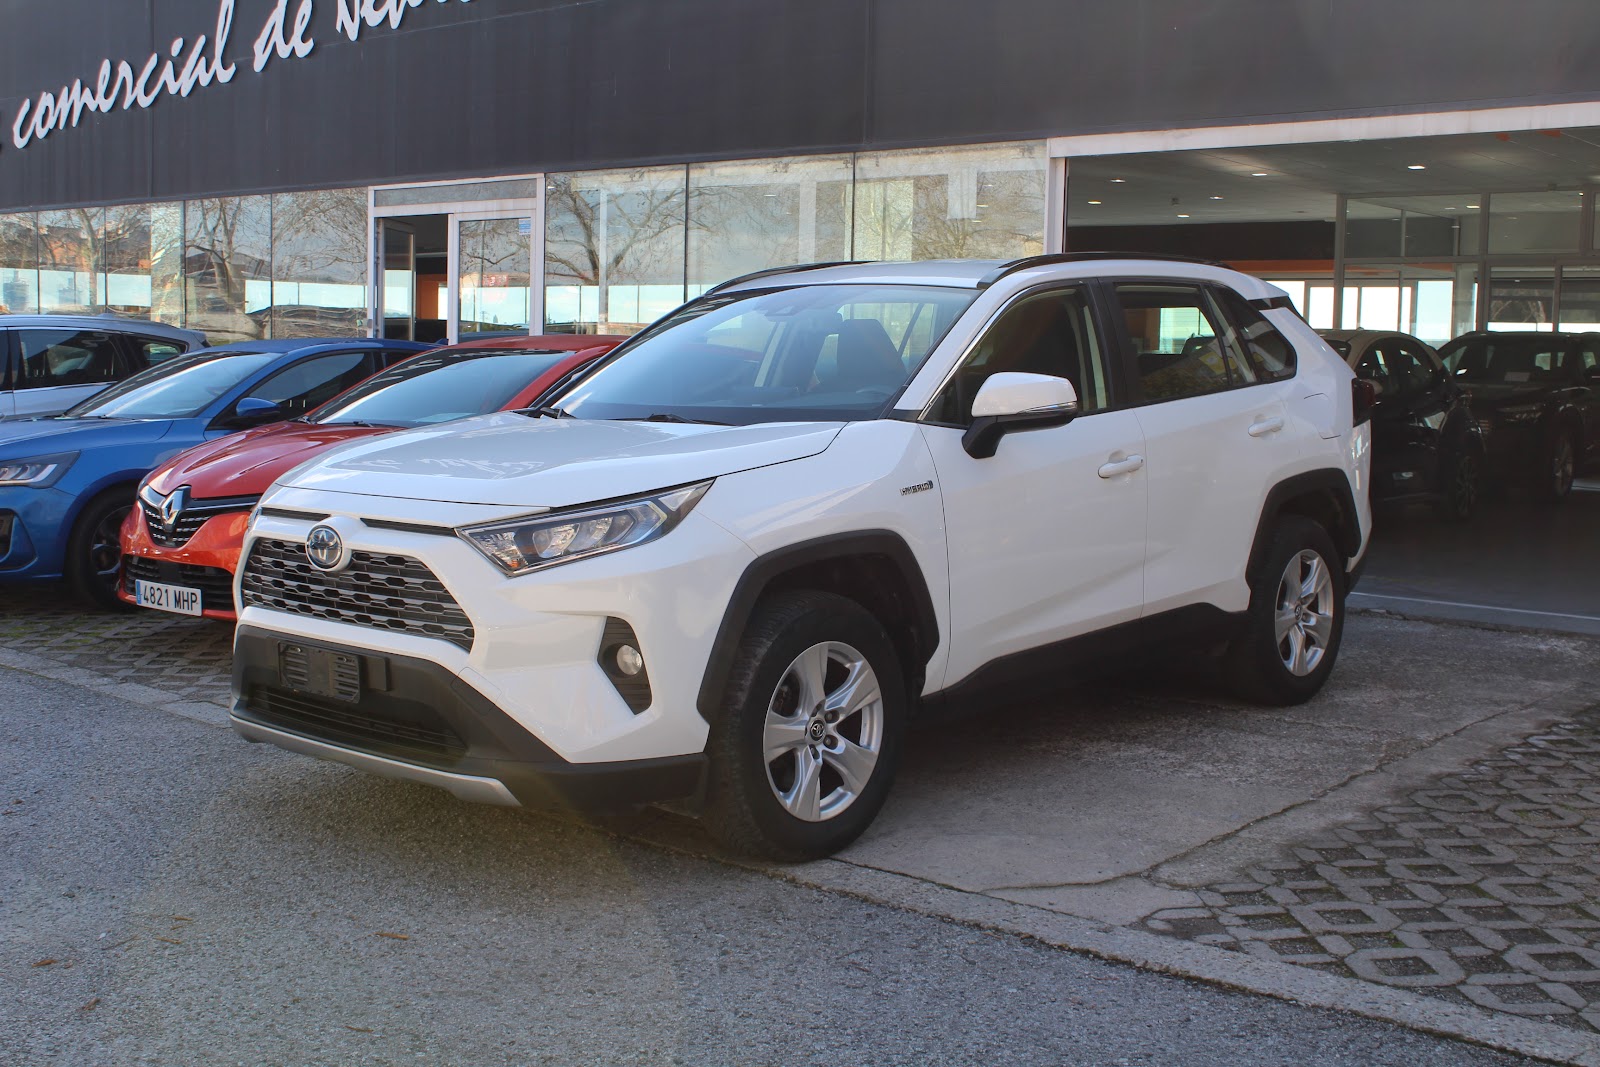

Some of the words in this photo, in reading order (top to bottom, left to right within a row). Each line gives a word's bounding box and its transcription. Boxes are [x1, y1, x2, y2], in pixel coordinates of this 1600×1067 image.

[13, 0, 236, 149] comercial
[254, 0, 314, 73] de
[143, 585, 170, 607] 4821
[174, 590, 198, 611] MHP
